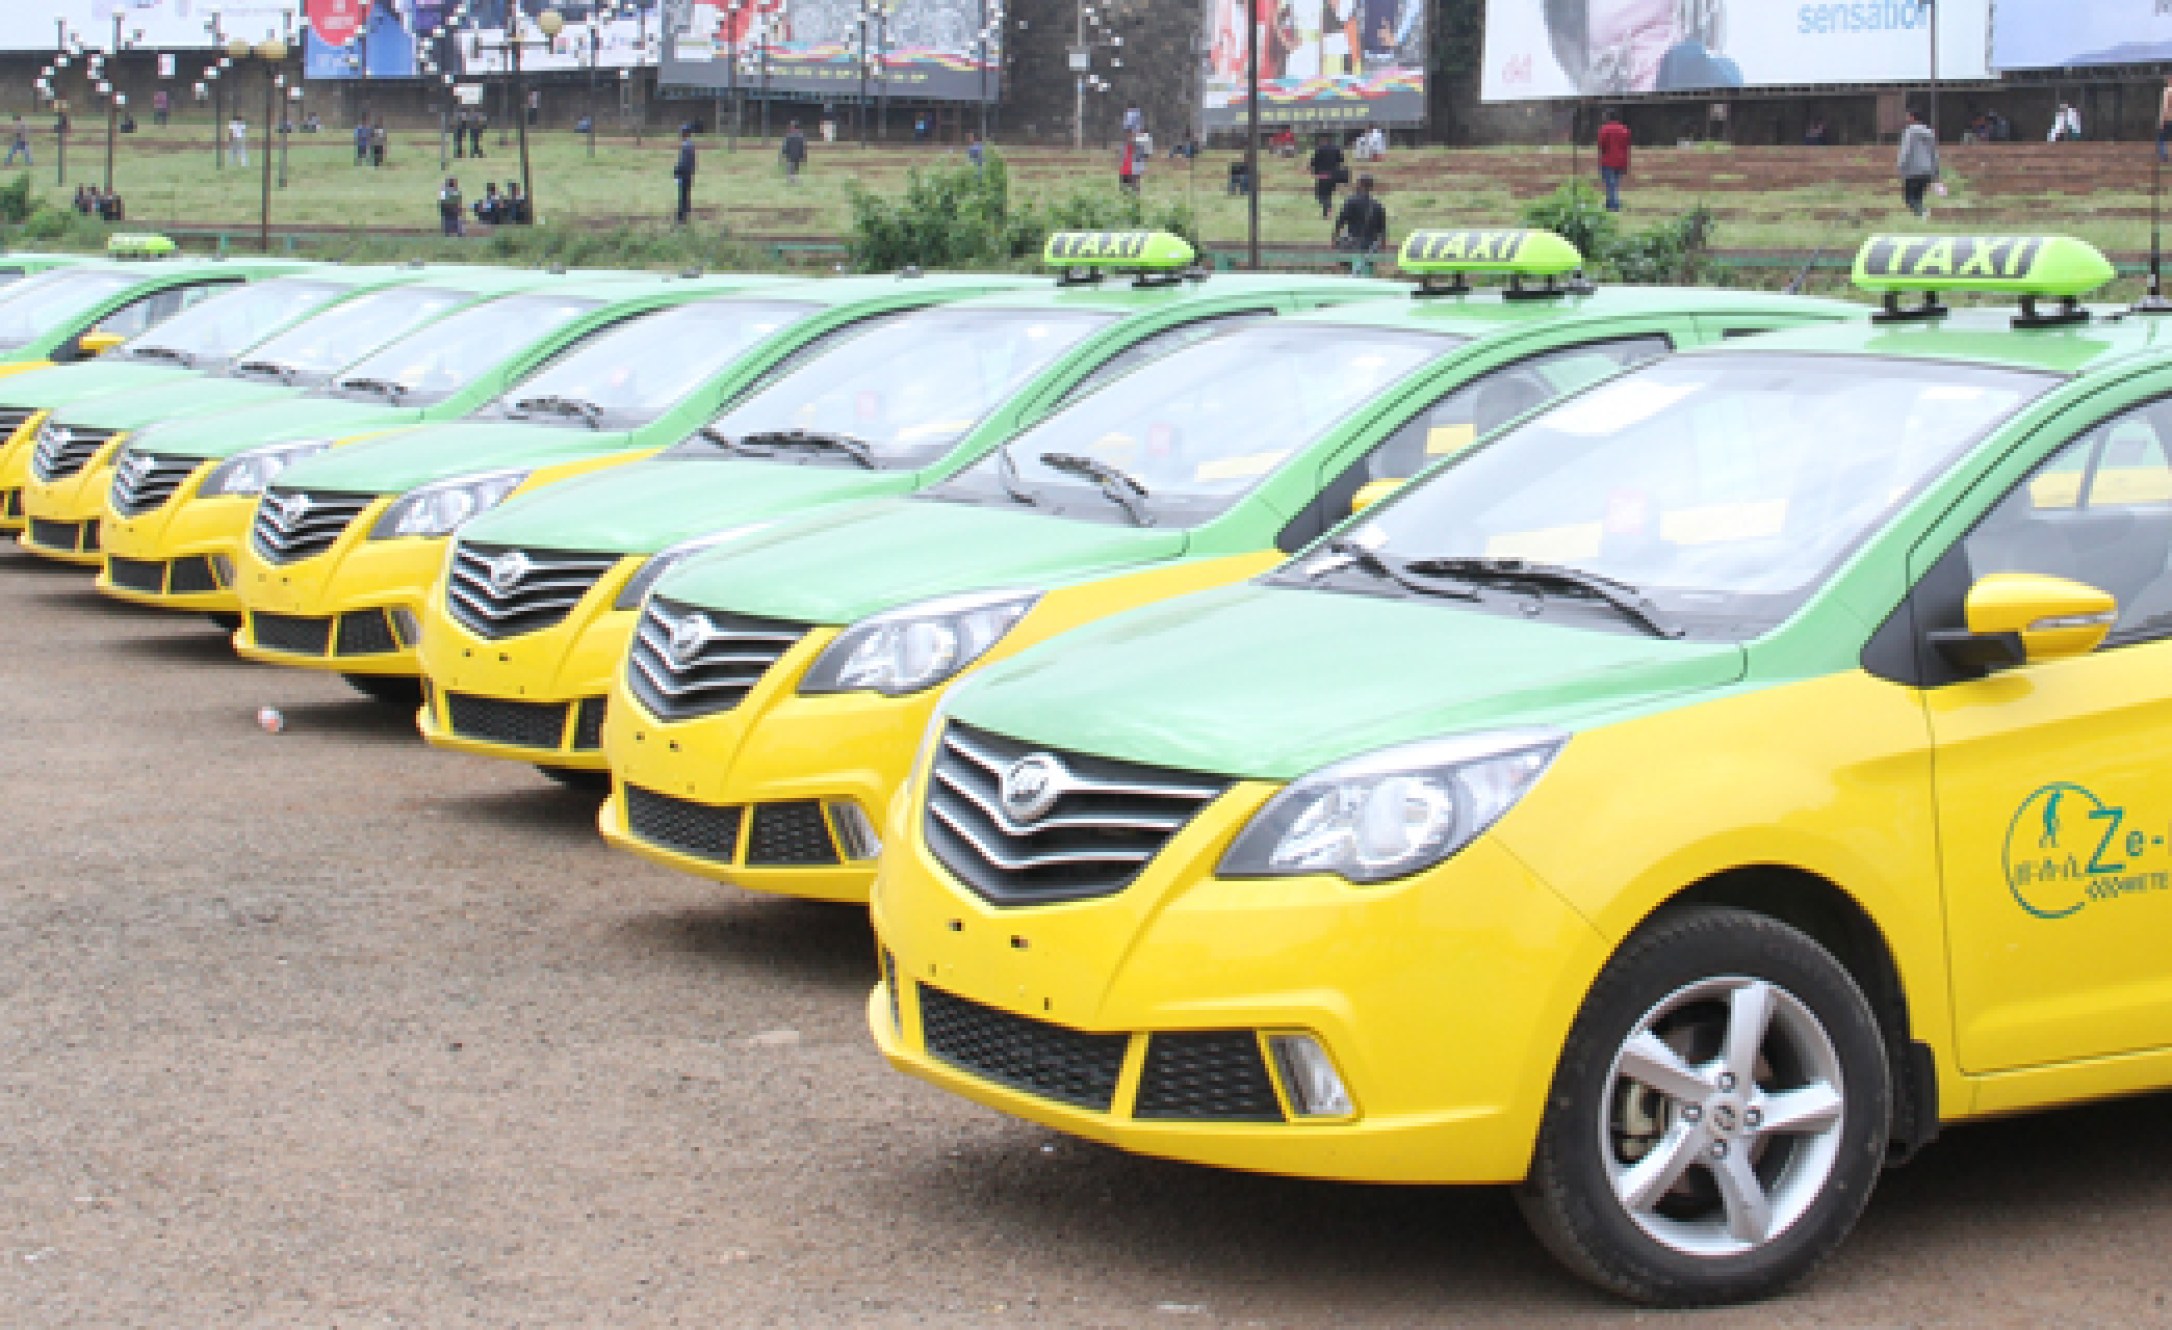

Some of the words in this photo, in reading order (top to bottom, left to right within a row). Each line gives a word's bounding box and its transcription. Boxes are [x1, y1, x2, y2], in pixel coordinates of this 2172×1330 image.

[1060, 232, 1144, 257] TAXI
[1420, 232, 1522, 260] TAXI
[1885, 237, 2033, 275] TAXI
